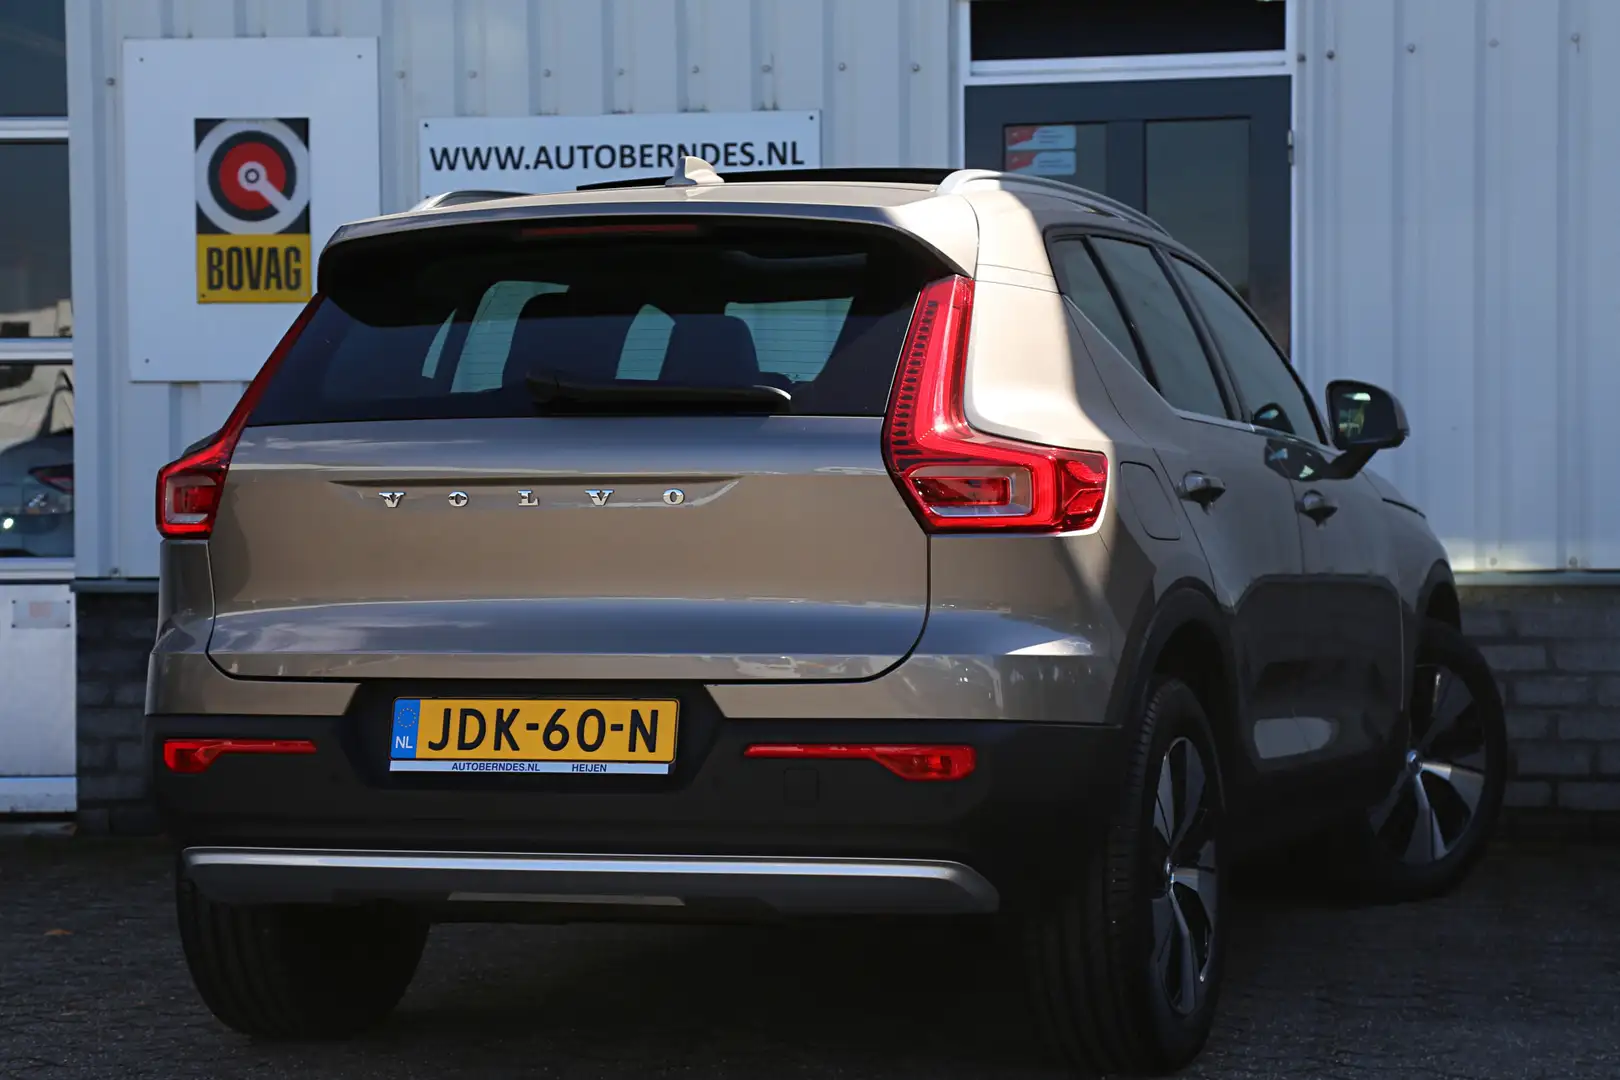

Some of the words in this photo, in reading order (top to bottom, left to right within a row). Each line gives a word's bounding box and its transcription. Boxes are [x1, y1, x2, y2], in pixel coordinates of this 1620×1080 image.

[429, 140, 805, 171] WWW.AUTOBERNDES.NL
[206, 246, 302, 291] BOVAG
[378, 488, 686, 508] VOLVO
[395, 735, 413, 749] NL
[428, 708, 659, 753] JDK-60-N
[451, 762, 541, 773] AUTOBERNDES.NL
[571, 763, 608, 773] HEIJEN
